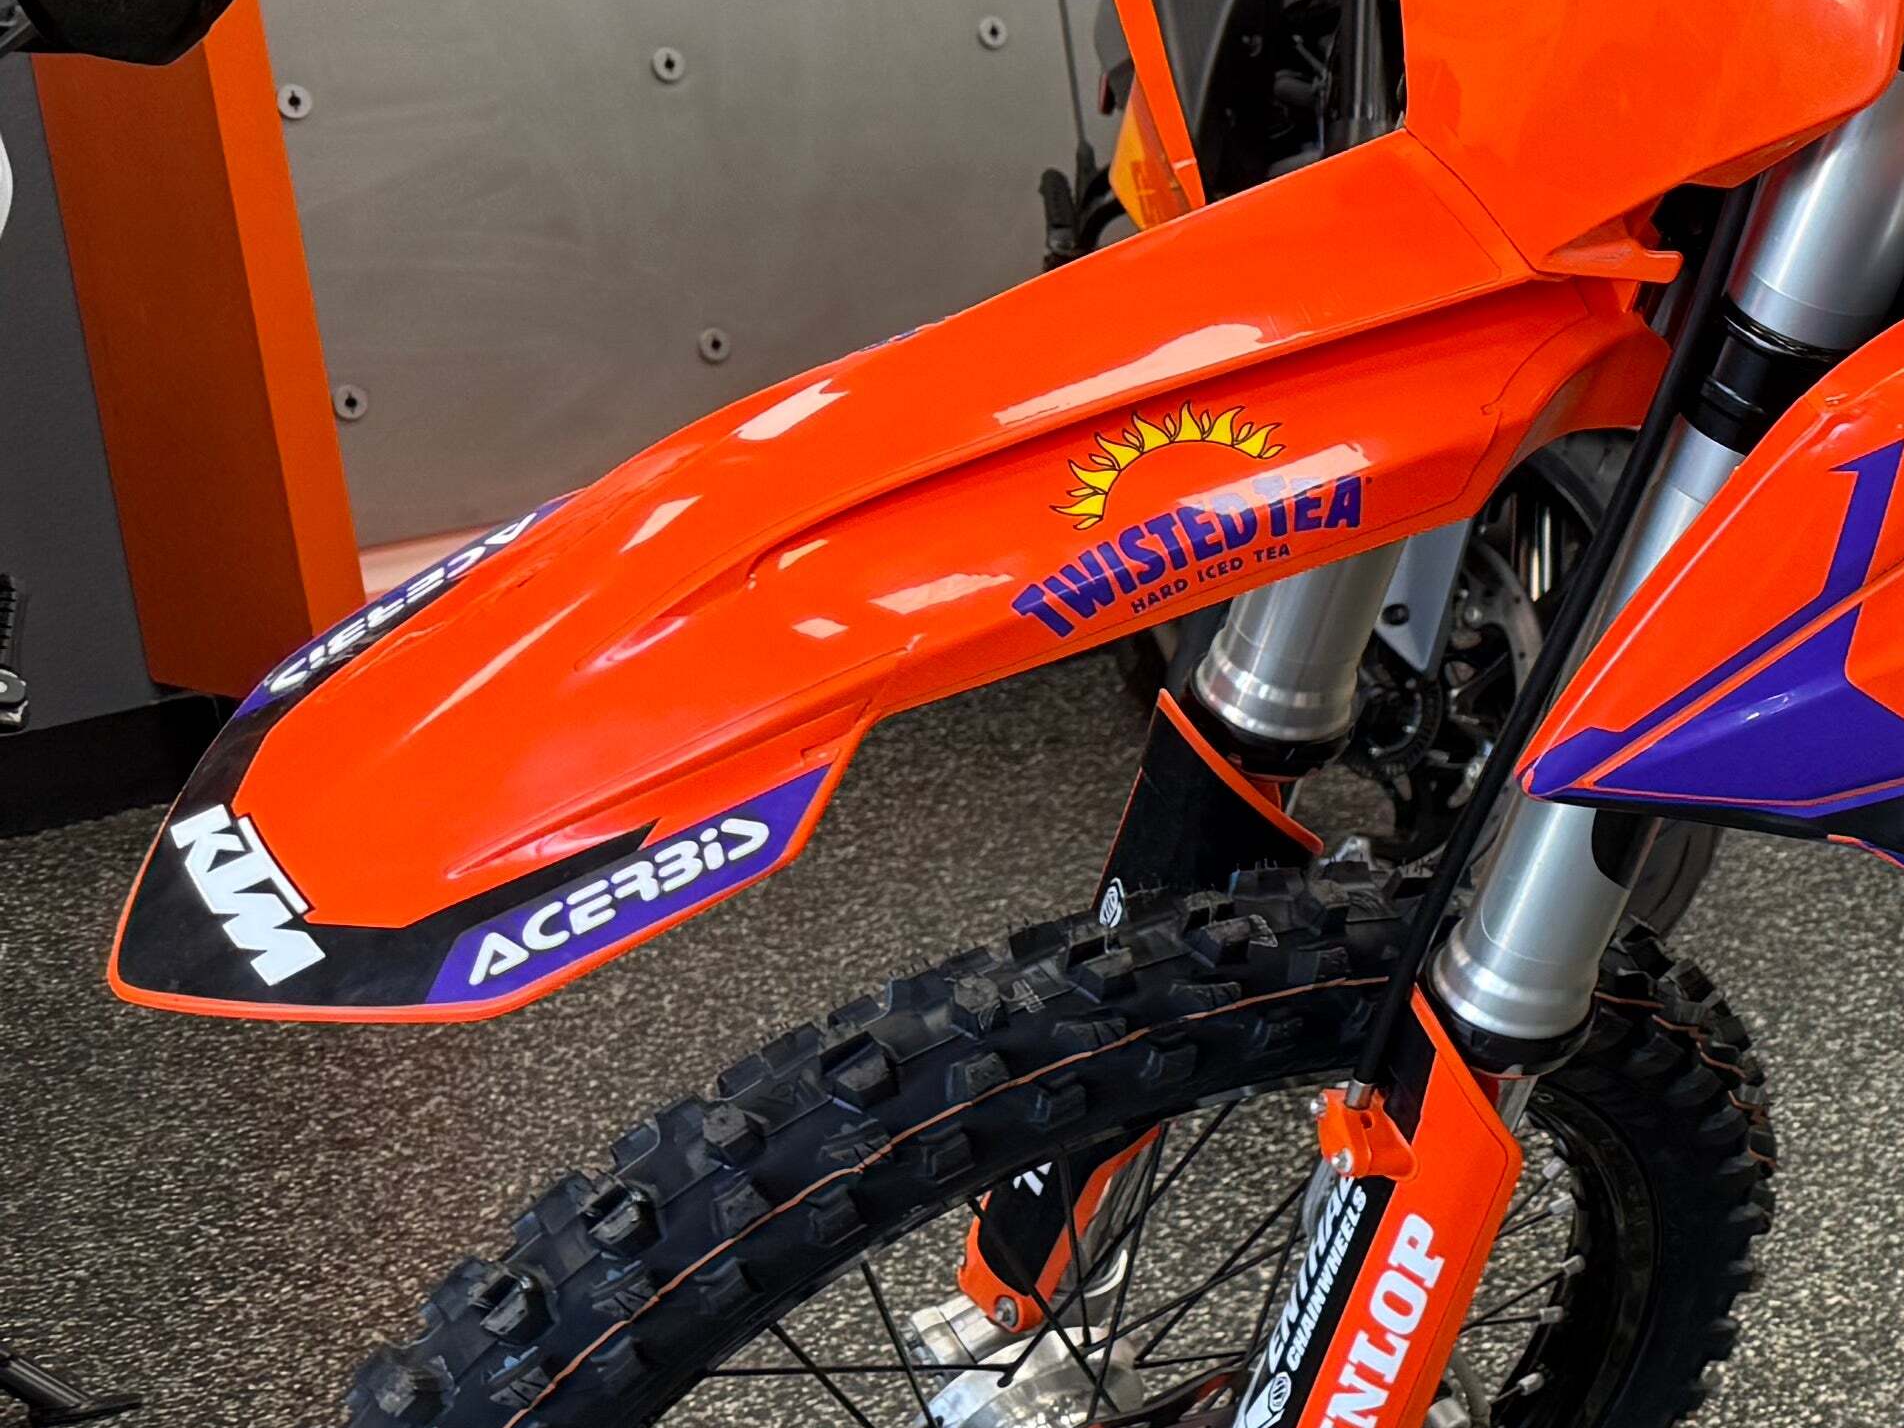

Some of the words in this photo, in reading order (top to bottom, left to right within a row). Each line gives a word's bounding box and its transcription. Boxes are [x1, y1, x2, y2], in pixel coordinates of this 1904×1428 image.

[1011, 492, 1258, 639] TWISTED
[1252, 474, 1363, 537] TEA
[1131, 578, 1188, 615] HARD
[1197, 555, 1245, 586] ICED
[1253, 543, 1292, 565] TEA
[168, 803, 326, 987] KTM
[468, 815, 772, 987] ACERBIS
[1286, 1184, 1368, 1373] CHAINWHEELS
